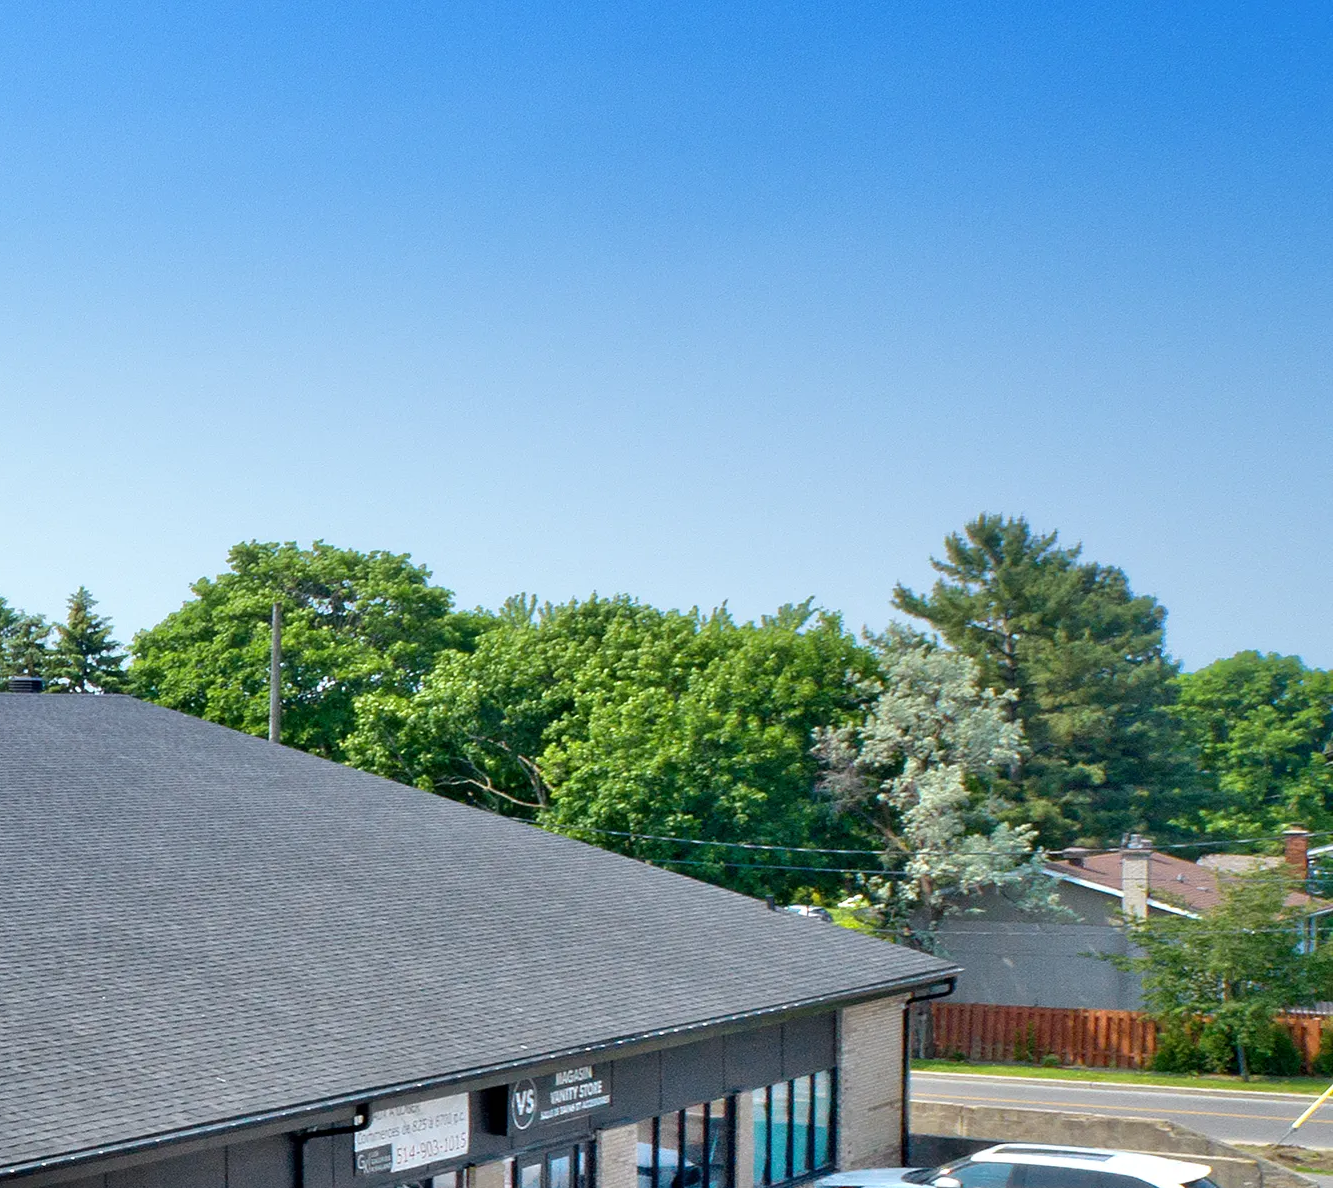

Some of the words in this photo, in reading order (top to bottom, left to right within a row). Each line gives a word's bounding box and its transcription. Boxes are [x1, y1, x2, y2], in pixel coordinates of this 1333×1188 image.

[555, 1065, 593, 1086] MAGASIN
[515, 1088, 535, 1116] VS
[550, 1085, 579, 1105] VANITY
[578, 1080, 603, 1098] STORE
[396, 1132, 466, 1165] 514-903-1015
